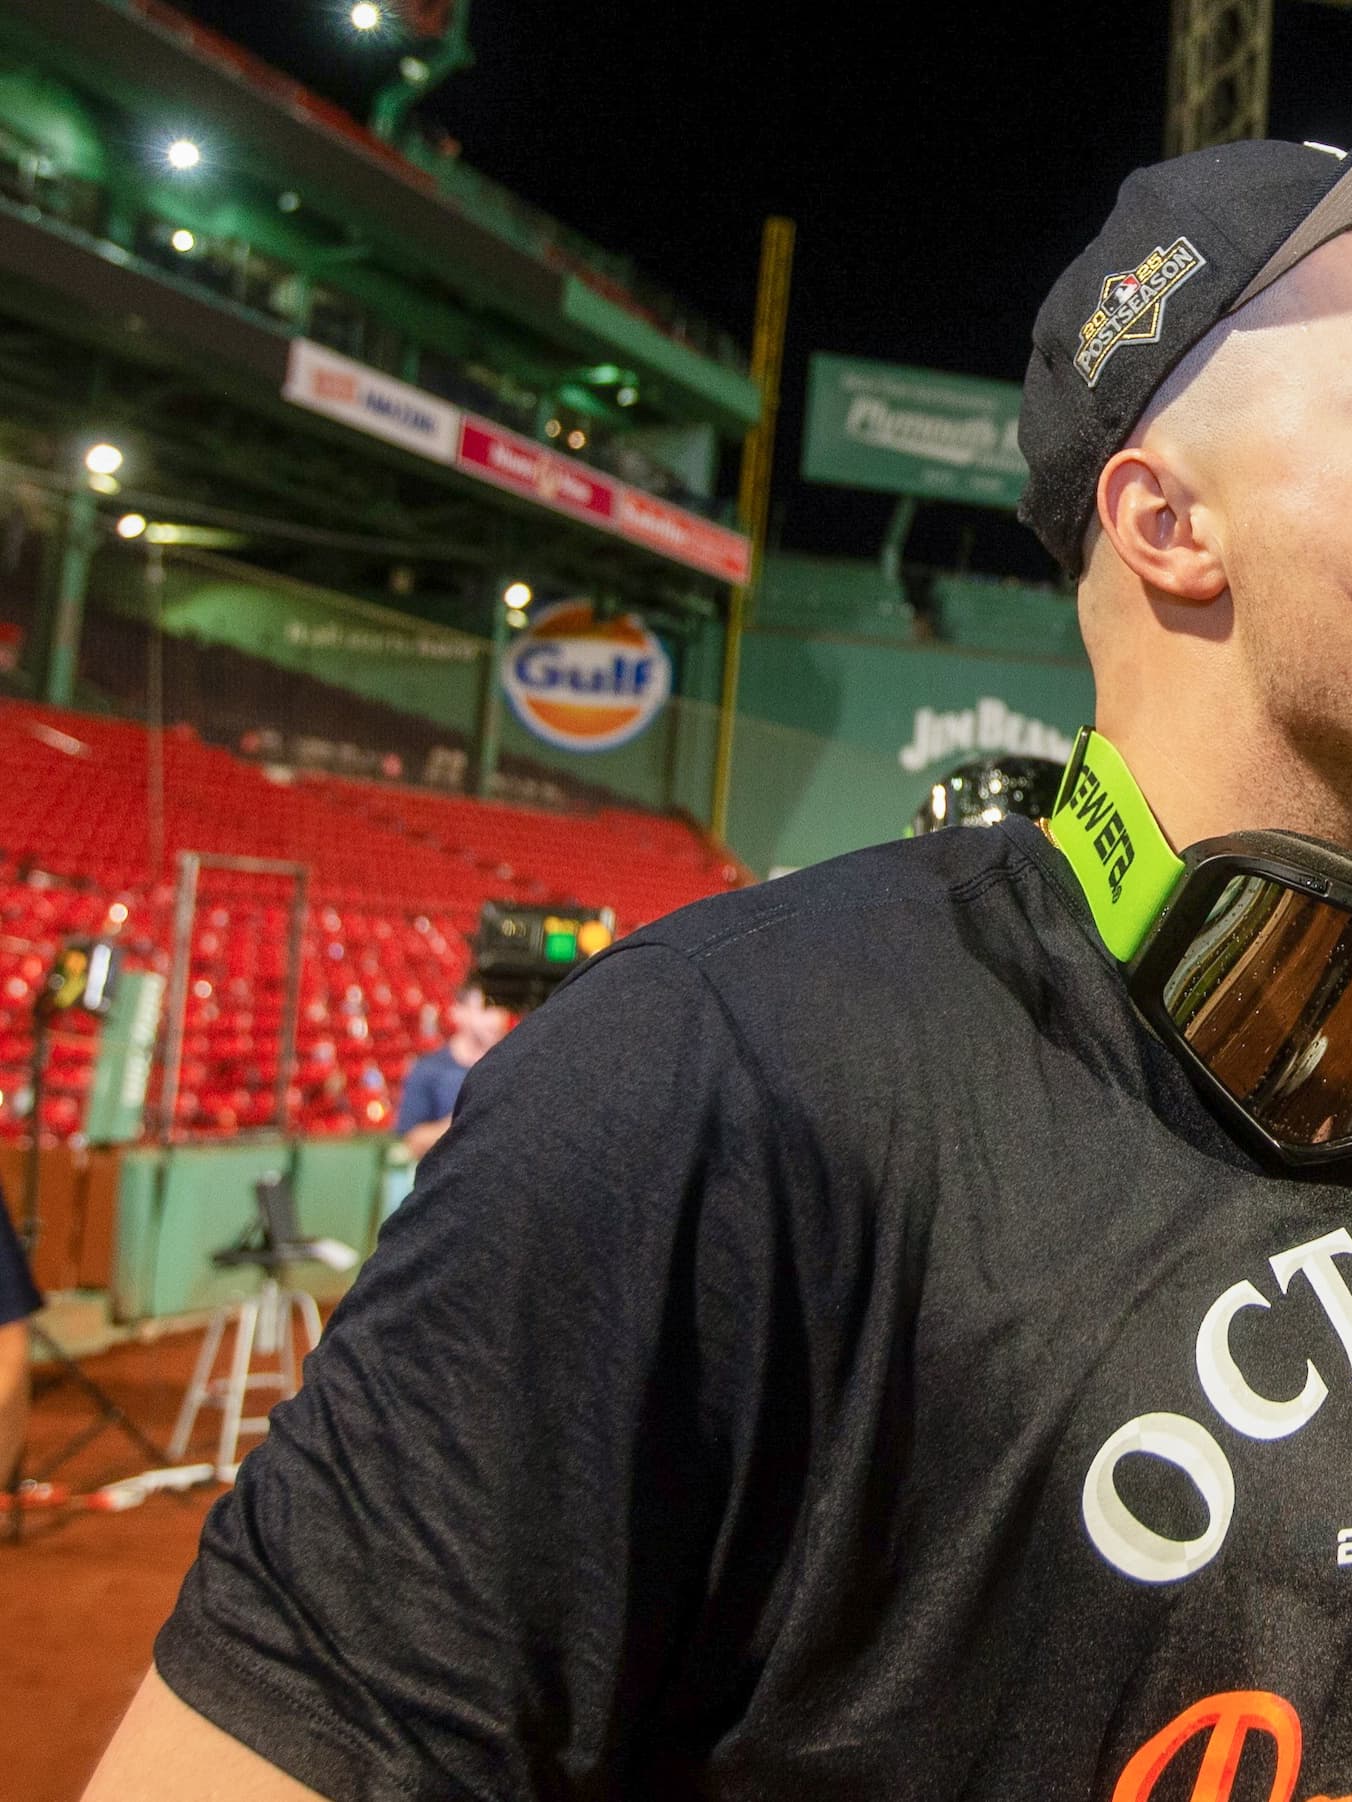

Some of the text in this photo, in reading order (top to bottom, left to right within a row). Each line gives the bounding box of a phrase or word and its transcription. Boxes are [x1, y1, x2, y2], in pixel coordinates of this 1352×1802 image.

[1080, 247, 1194, 373] POSTSEASON
[1082, 253, 1162, 341] 20 25
[515, 644, 651, 694] Gulf
